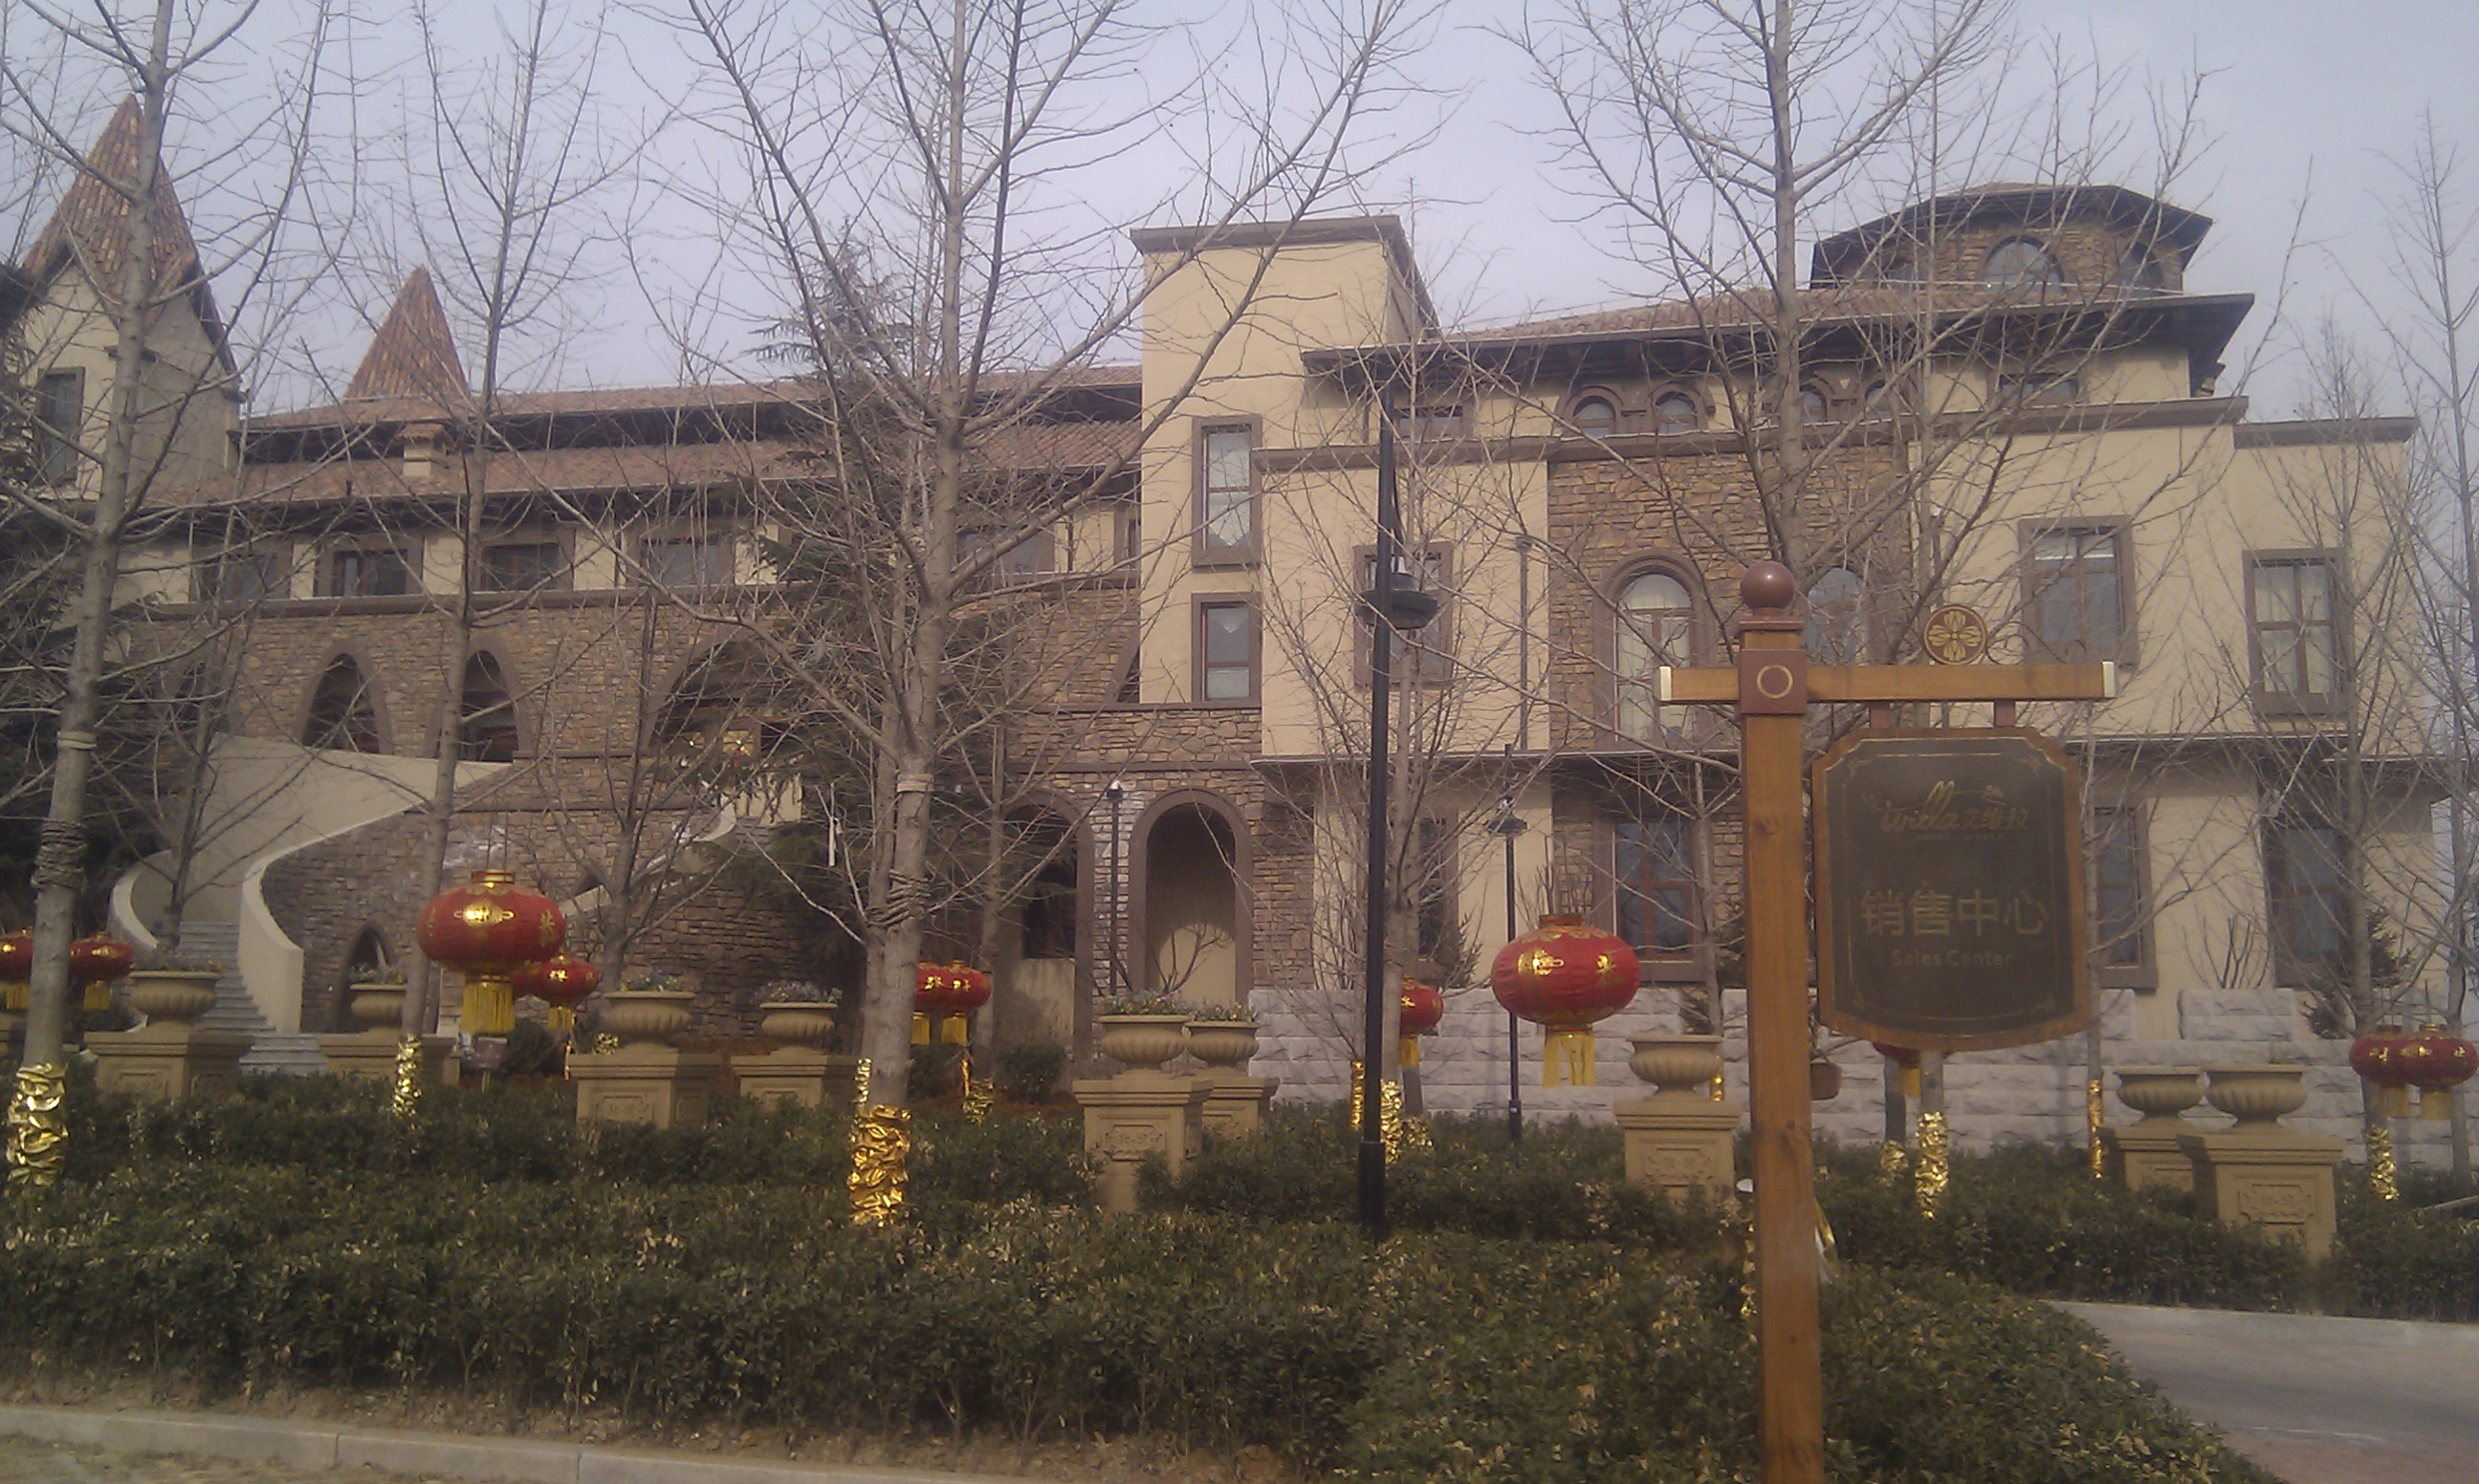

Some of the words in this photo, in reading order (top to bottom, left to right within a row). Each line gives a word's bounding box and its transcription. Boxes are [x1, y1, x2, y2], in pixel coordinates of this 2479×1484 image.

[1861, 889, 2050, 937] 销售中心
[1893, 949, 1942, 967] Sales
[1947, 949, 2012, 967] Center
